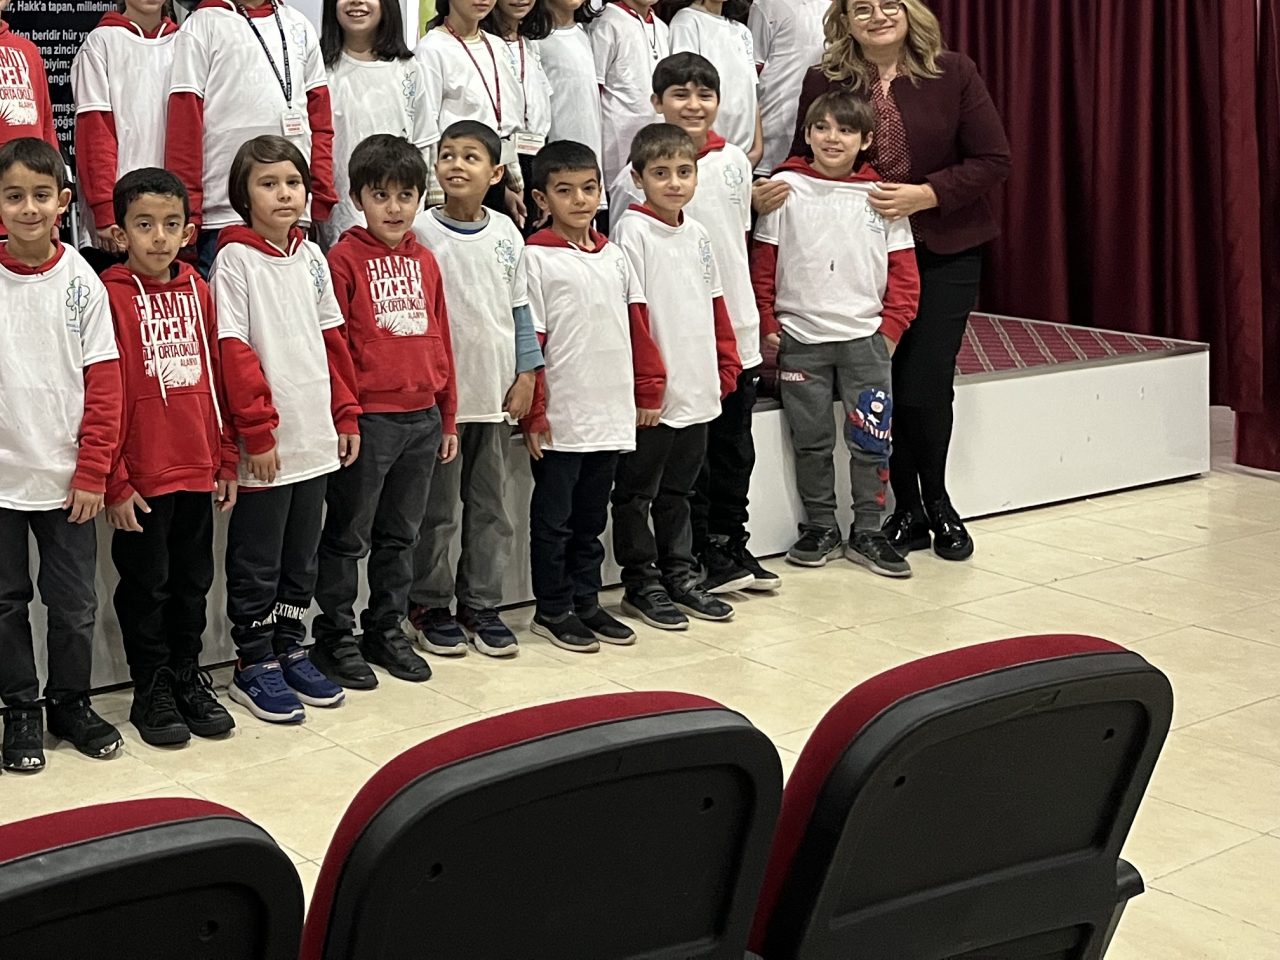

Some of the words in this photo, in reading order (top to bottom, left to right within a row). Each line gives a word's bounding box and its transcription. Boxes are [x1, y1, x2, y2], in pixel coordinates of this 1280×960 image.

[48, 2, 75, 14] tapan,
[76, 1, 118, 12] milletimin
[32, 29, 61, 40] beridir
[62, 29, 78, 41] hür
[53, 44, 78, 55] zincir
[44, 58, 70, 72] biyim:
